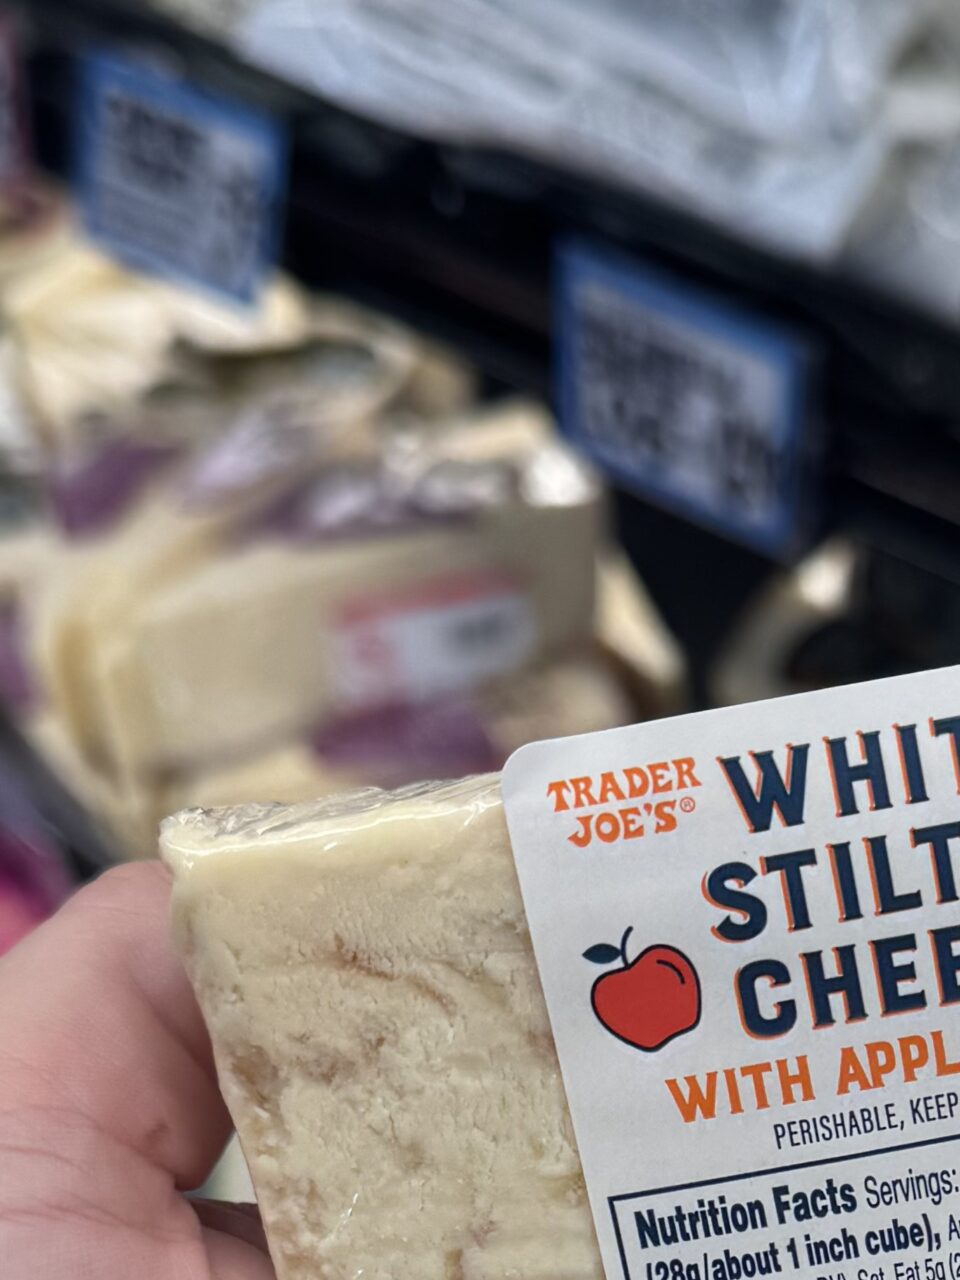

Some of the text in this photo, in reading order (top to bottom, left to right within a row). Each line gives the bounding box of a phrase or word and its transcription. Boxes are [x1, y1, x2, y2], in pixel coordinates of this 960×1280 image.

[547, 757, 702, 812] TRADER
[664, 1054, 816, 1123] WITH
[773, 1102, 905, 1150] PERISHABLE,
[909, 1091, 959, 1125] KEEP
[633, 1195, 768, 1250] Nutrition
[771, 1178, 858, 1225] Facts
[863, 1168, 960, 1209] Servings:
[803, 1227, 861, 1267] inch
[864, 1212, 942, 1256] cube),
